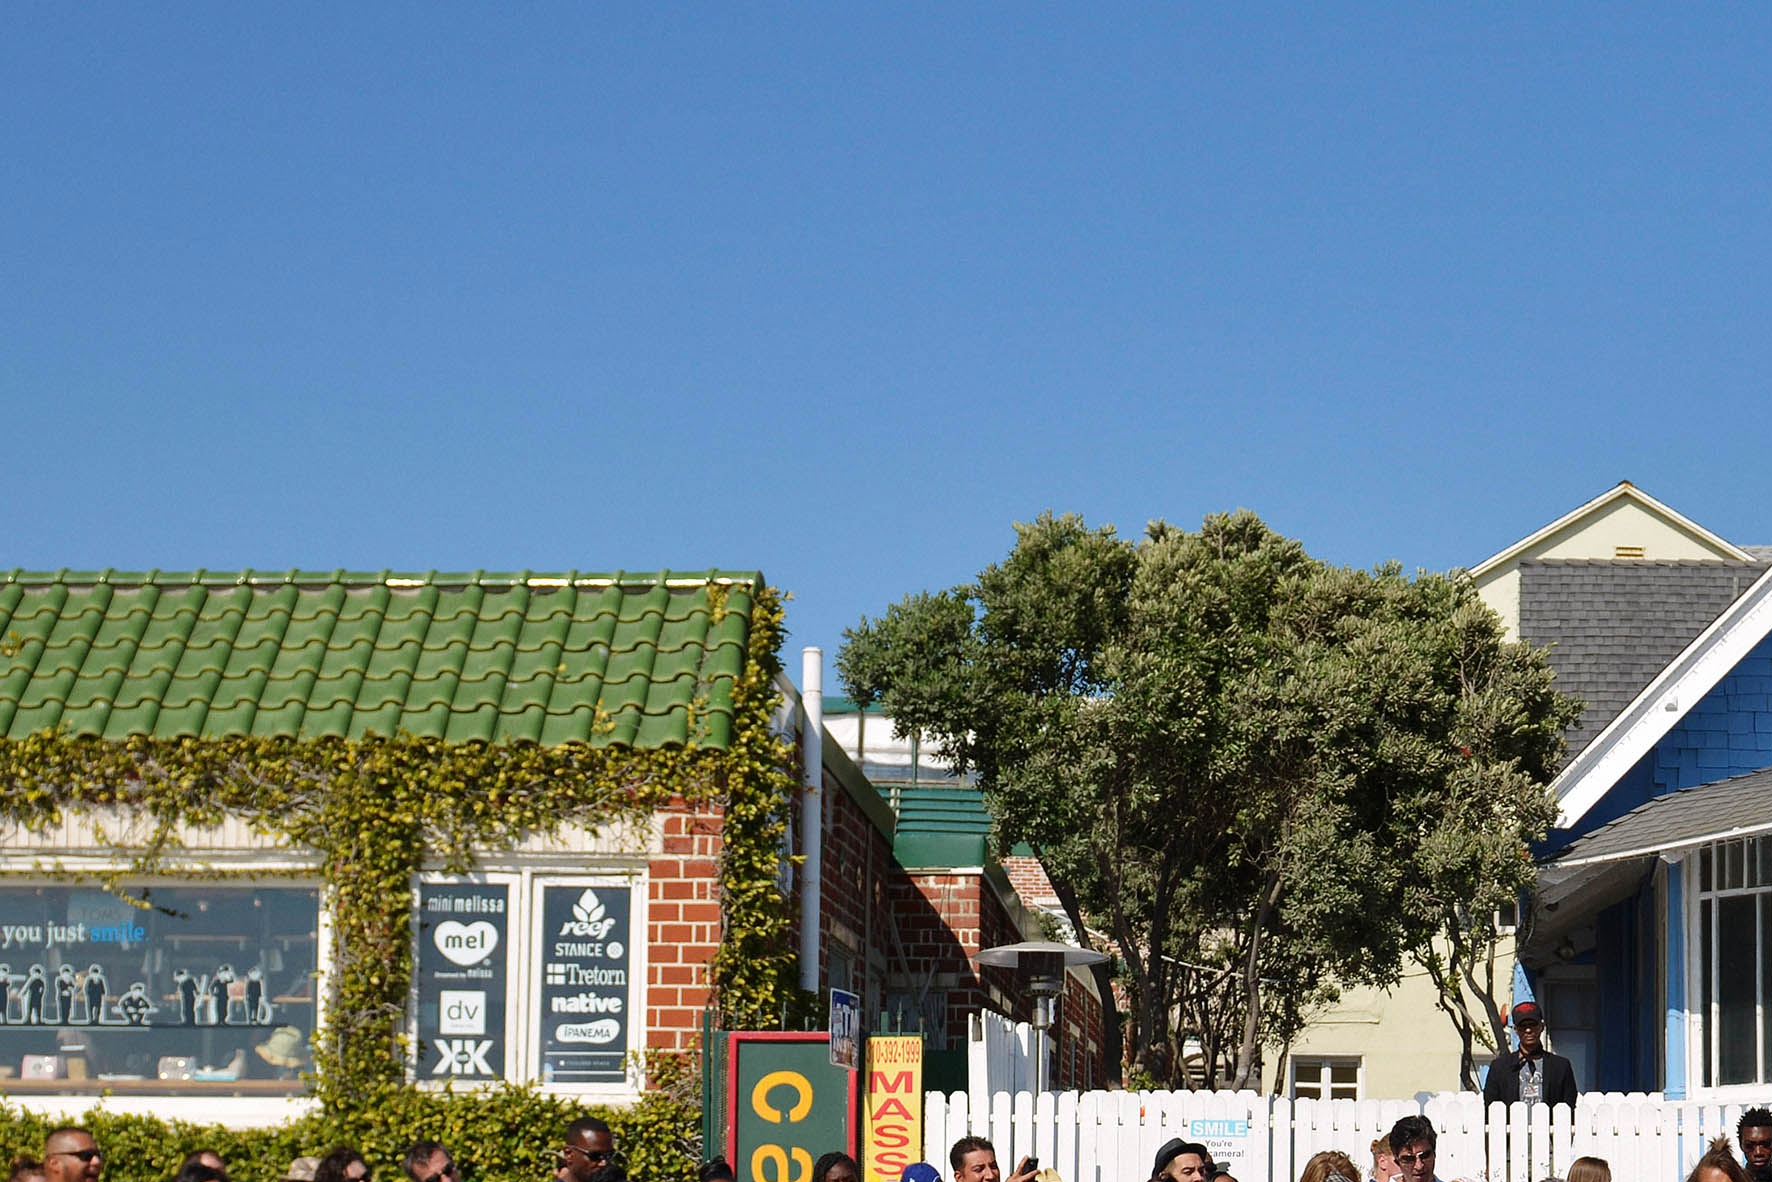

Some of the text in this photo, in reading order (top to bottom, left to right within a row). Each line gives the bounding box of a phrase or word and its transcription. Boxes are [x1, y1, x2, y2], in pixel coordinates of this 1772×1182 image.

[427, 895, 504, 913] mini melissa
[2, 925, 41, 949] you
[46, 920, 86, 948] just
[560, 918, 616, 940] reef
[445, 930, 484, 949] mel
[555, 942, 603, 957] STANCE
[566, 963, 626, 985] Tretorn
[447, 1000, 478, 1020] dv
[551, 992, 623, 1013] native
[866, 1040, 921, 1064] 310-392-1999
[1193, 1121, 1246, 1136] SMILE
[1205, 1140, 1233, 1148] You're
[1210, 1149, 1245, 1158] amera!
